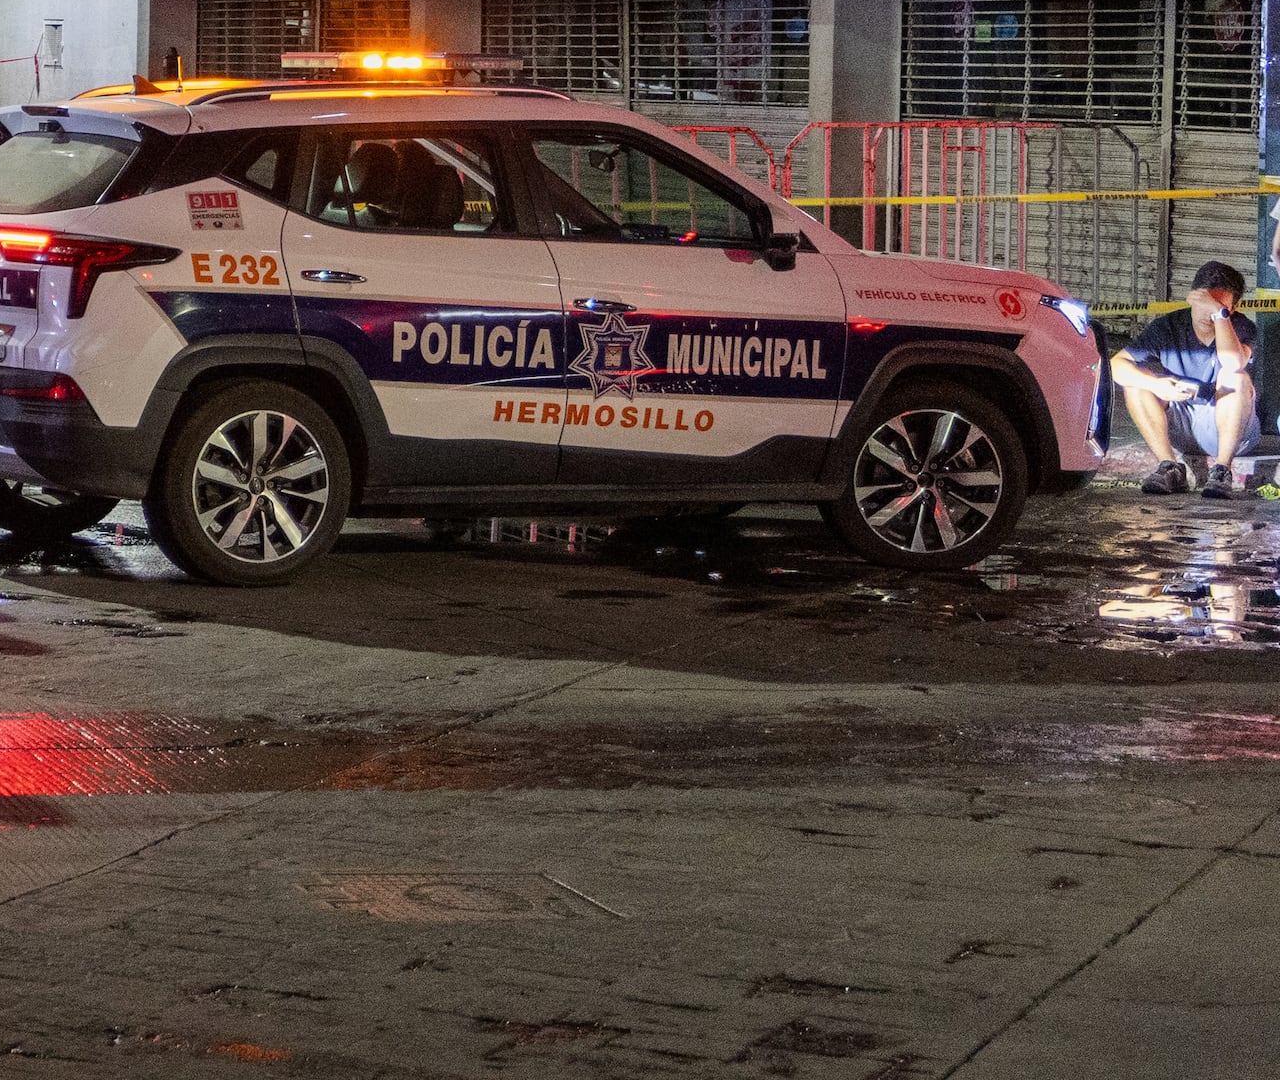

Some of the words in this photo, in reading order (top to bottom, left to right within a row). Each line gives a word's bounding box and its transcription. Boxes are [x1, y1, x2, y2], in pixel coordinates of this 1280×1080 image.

[191, 193, 234, 209] 911
[191, 212, 241, 220] EMERGENCIAS
[191, 252, 214, 284] E
[219, 253, 281, 286] 232
[855, 288, 917, 302] VEHÍCULO
[392, 318, 556, 370] POLICÍA
[666, 331, 828, 380] MUNICIPAL
[493, 400, 715, 432] HERMOSILLO
